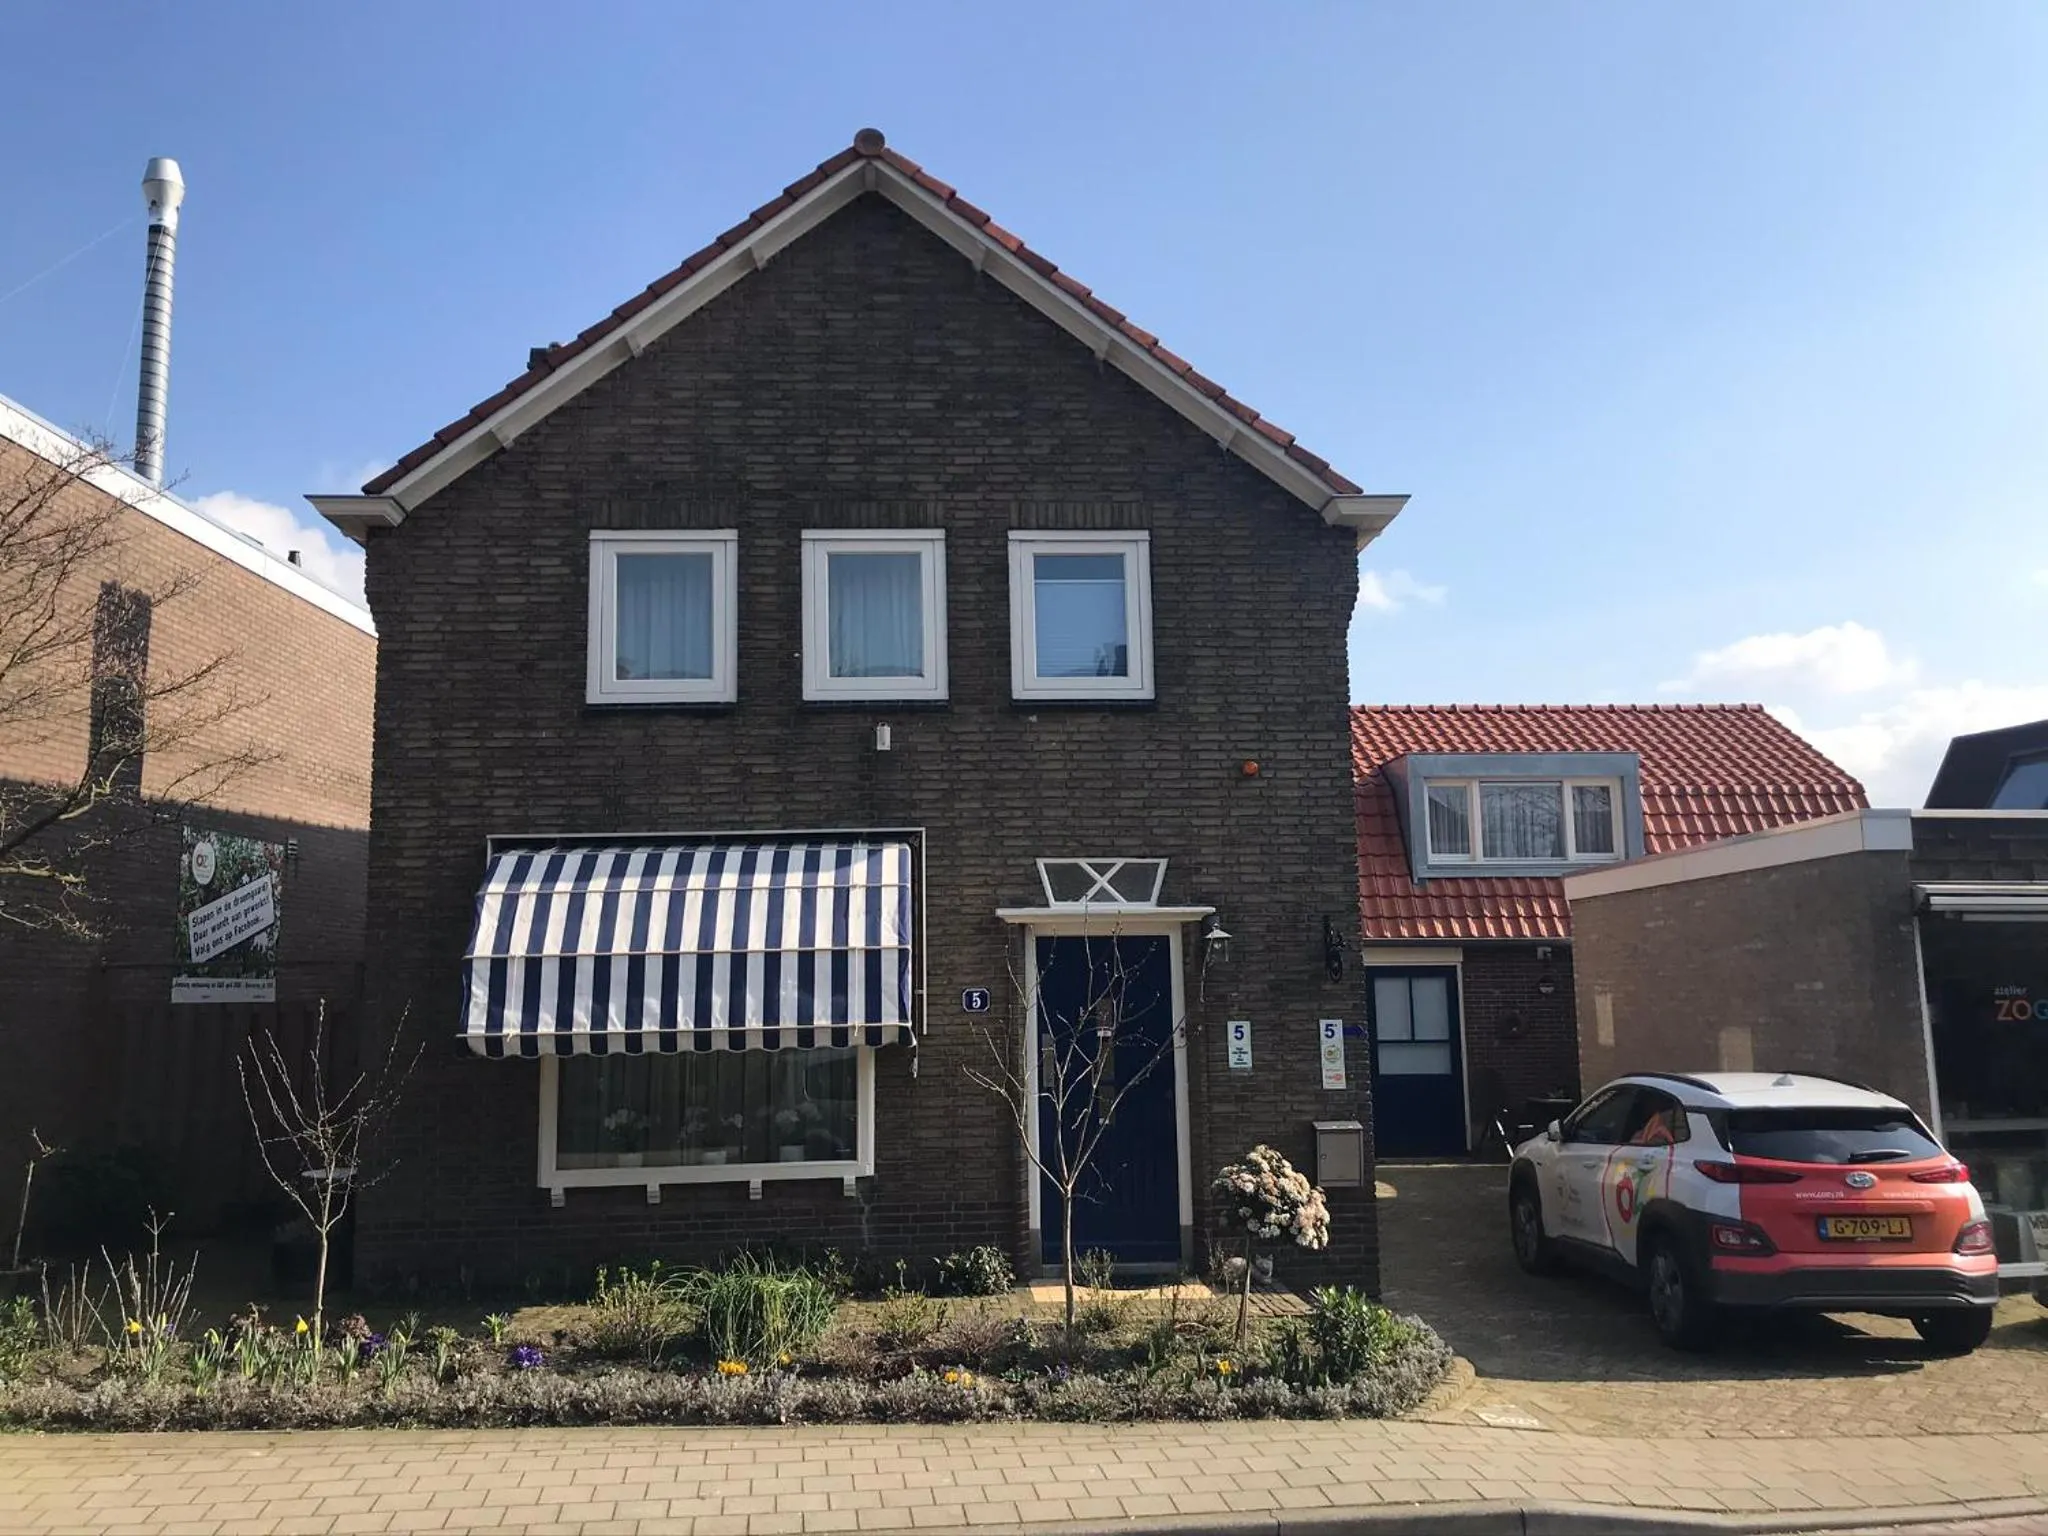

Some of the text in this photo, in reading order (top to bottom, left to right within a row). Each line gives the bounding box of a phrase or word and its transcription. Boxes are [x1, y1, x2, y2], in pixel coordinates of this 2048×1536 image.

[192, 911, 215, 928] Slapen
[216, 906, 222, 915] in
[195, 943, 210, 957] Volg
[972, 992, 981, 1008] 5
[1234, 1025, 1244, 1040] 5
